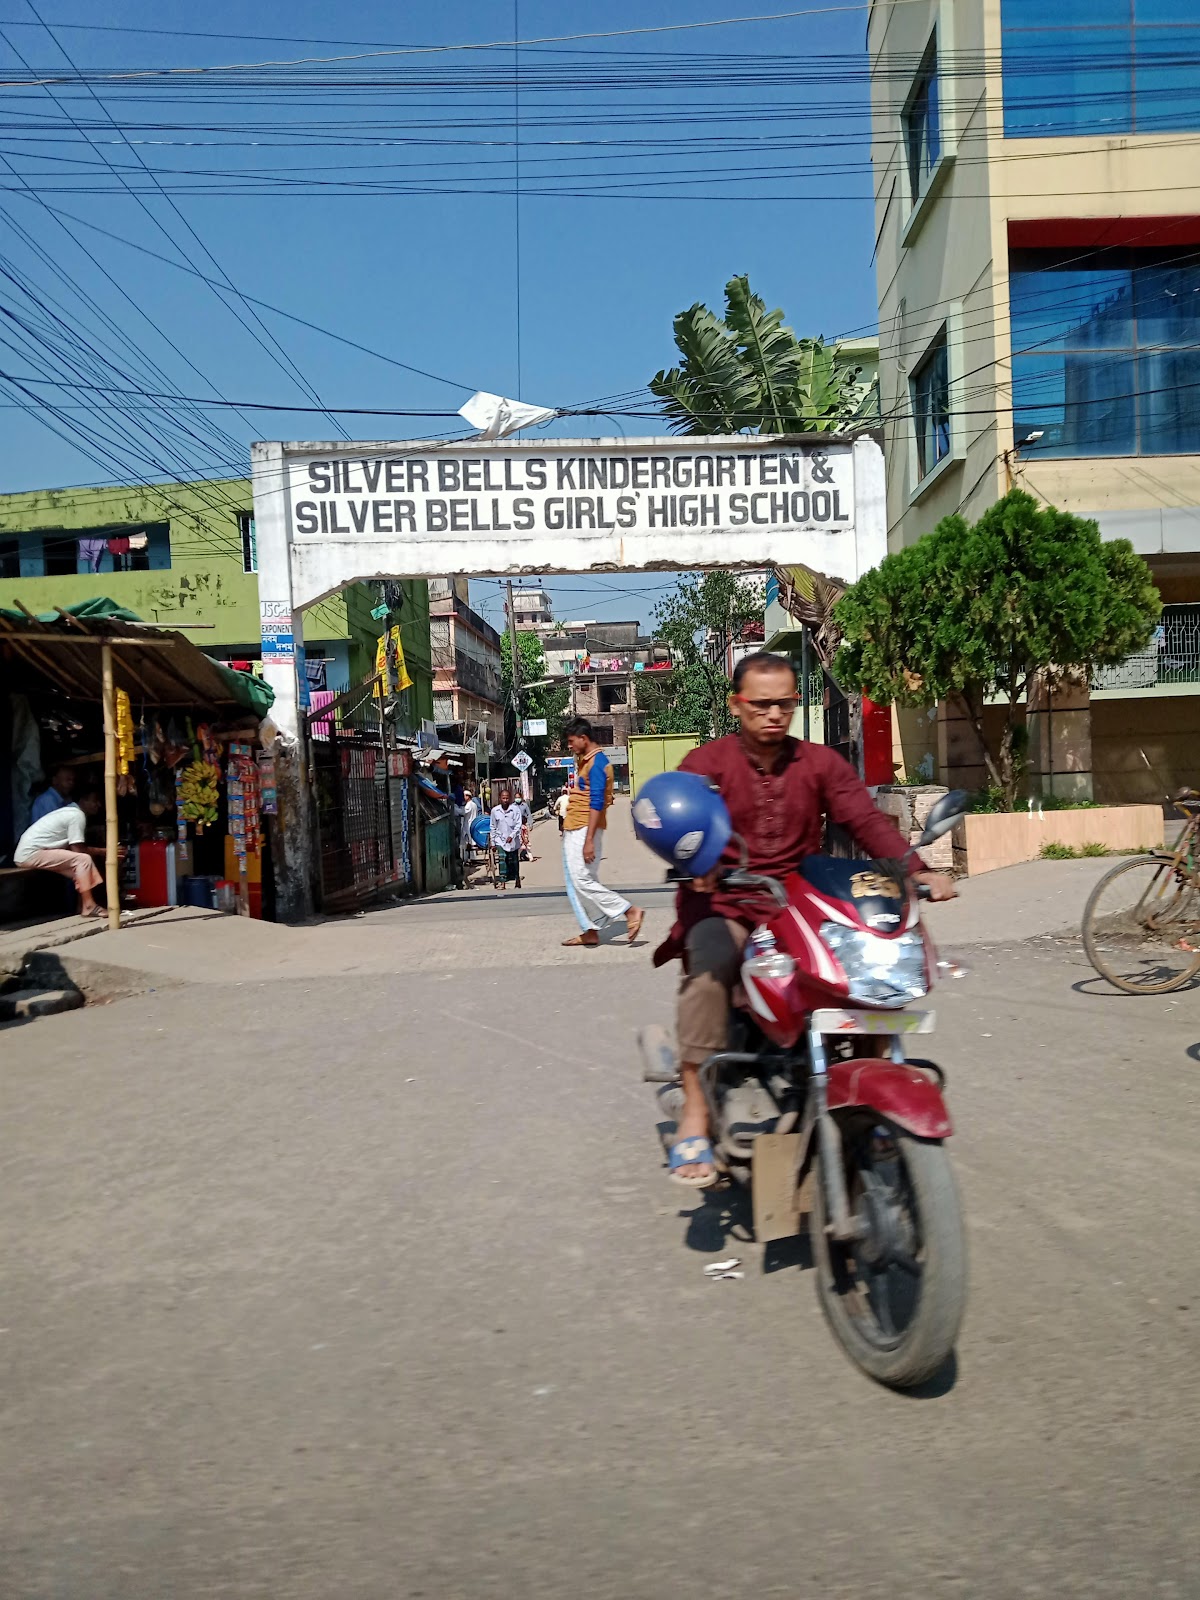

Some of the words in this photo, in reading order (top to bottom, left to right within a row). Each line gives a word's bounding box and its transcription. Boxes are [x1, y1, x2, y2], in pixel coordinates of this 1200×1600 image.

[309, 460, 429, 494] SILVER
[438, 457, 548, 492] BELLS
[556, 453, 800, 490] KINDERGARTEN
[811, 454, 835, 483] &
[295, 499, 417, 534] SILVER
[425, 497, 535, 532] BELLS
[647, 492, 720, 527] HIGH
[728, 489, 849, 525] SCHOOL
[261, 624, 293, 633] EXPONENT
